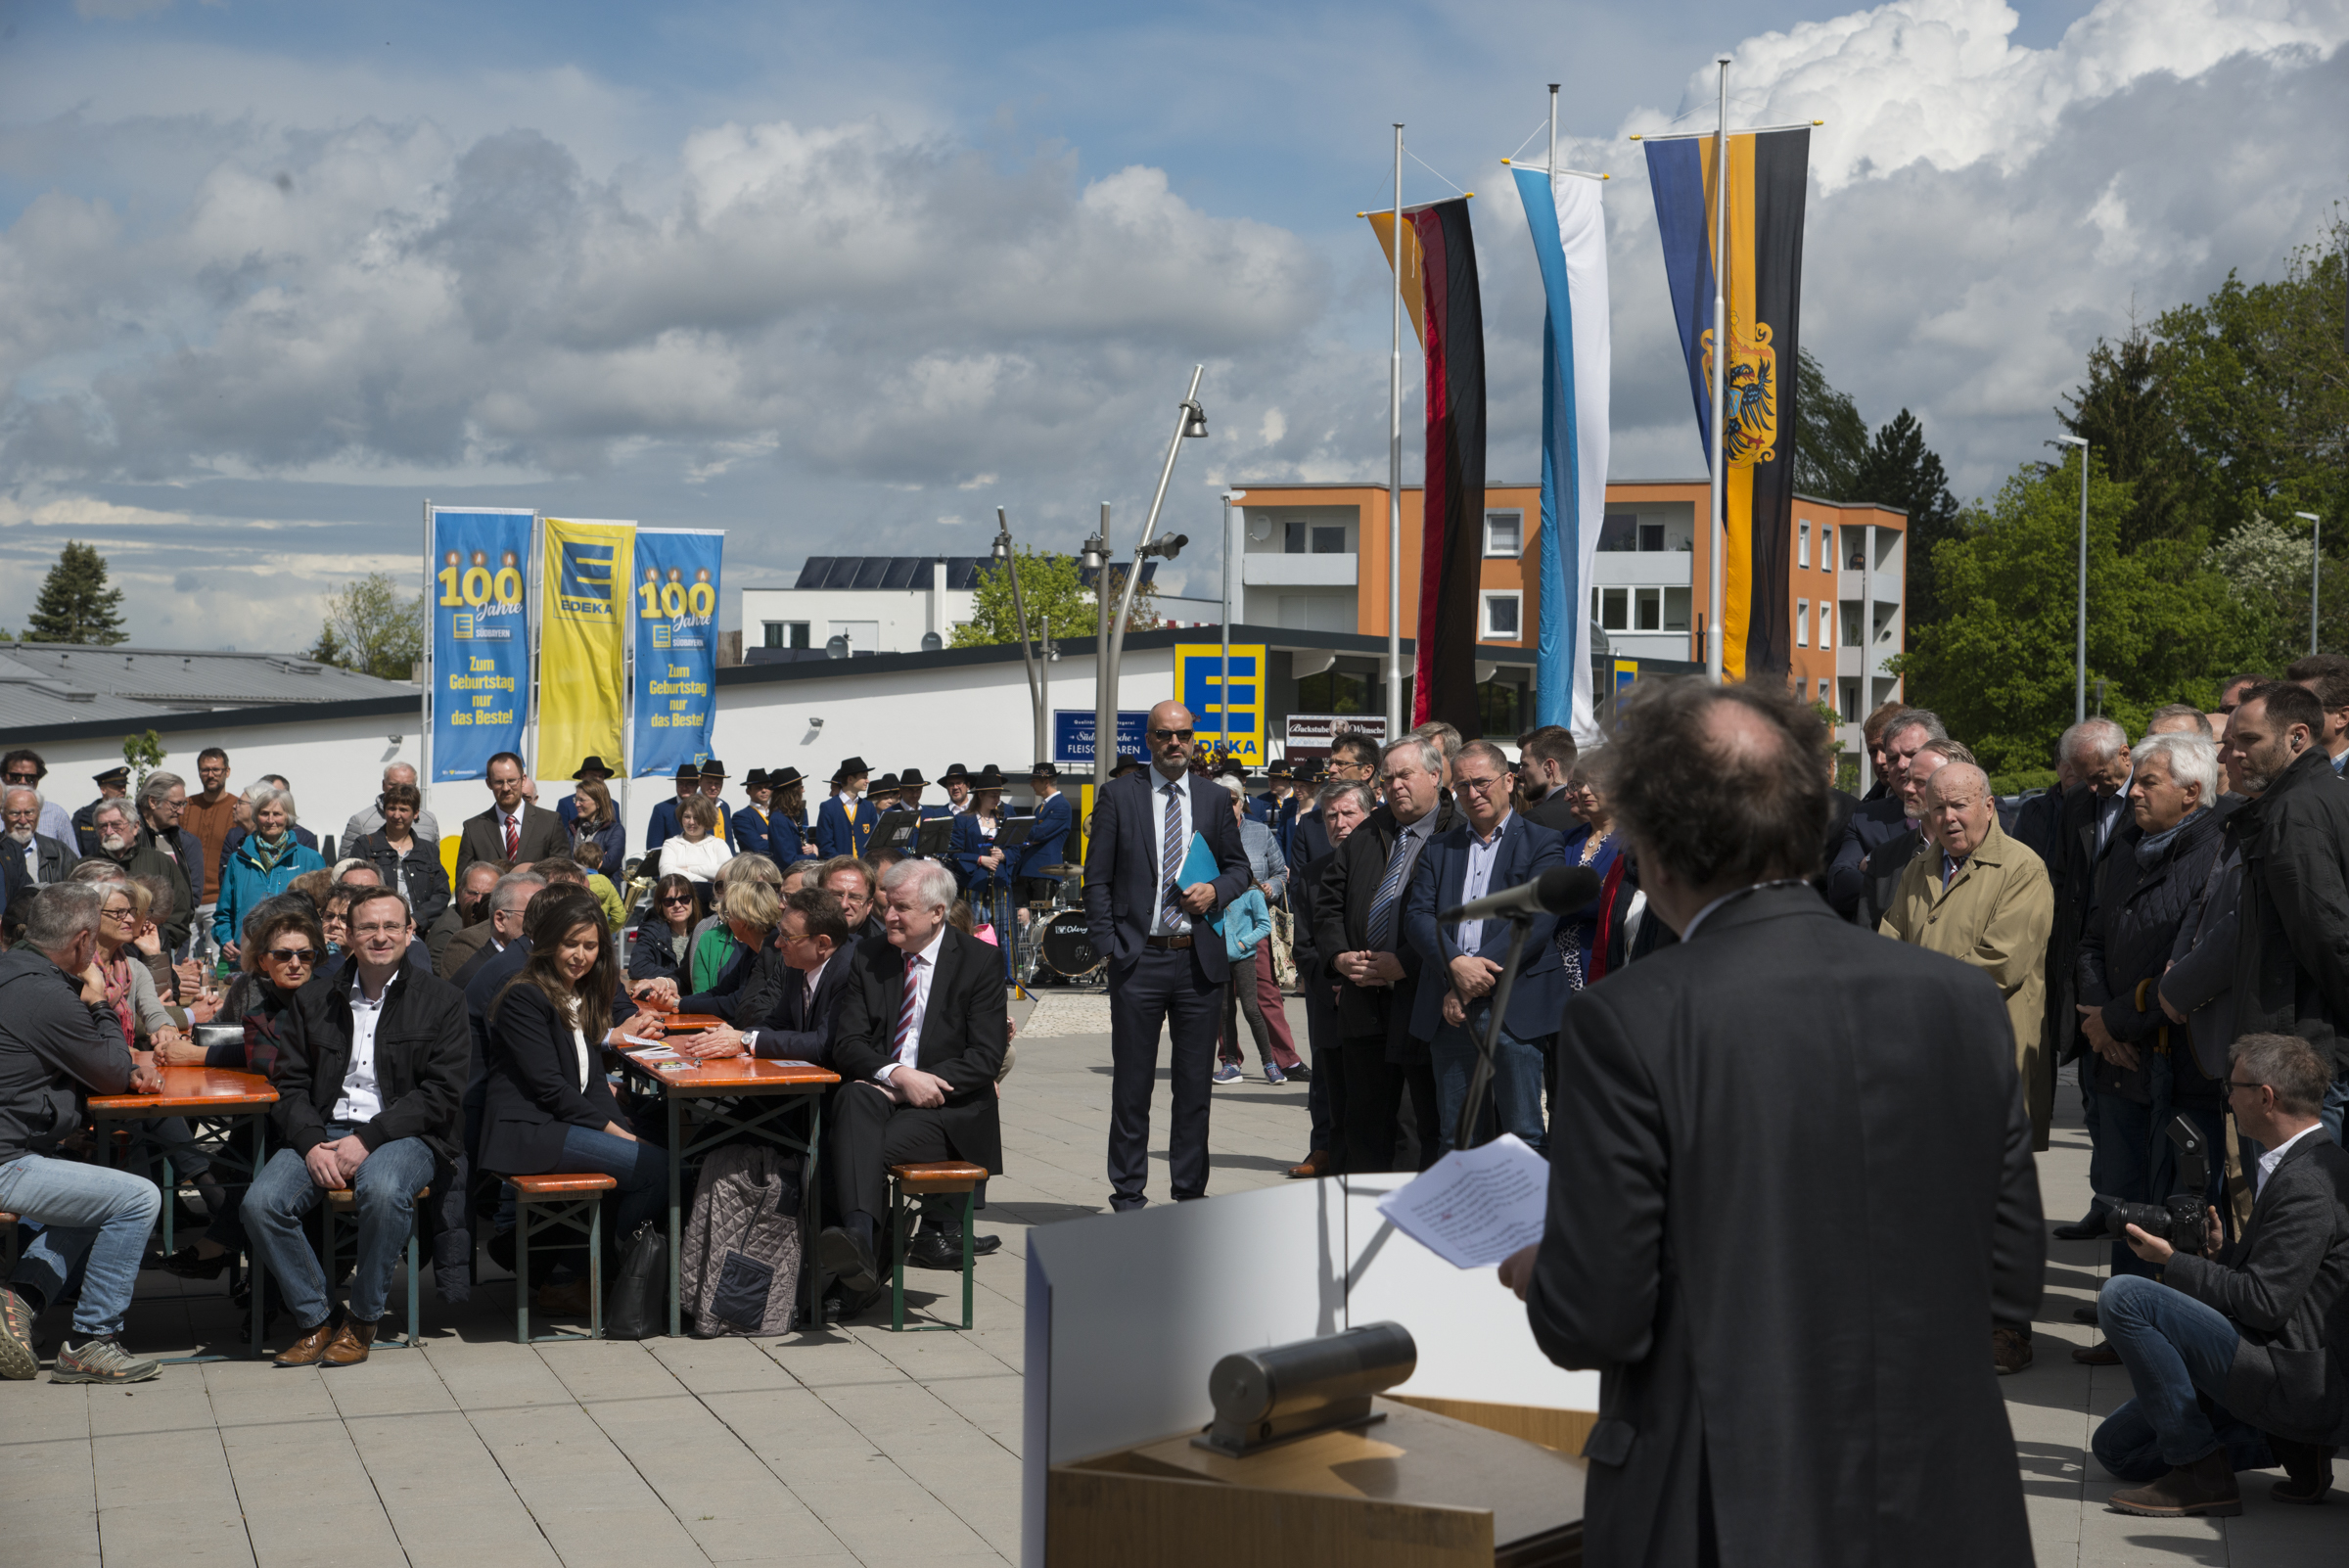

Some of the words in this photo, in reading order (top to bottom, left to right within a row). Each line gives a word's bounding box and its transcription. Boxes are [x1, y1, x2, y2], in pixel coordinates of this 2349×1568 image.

[438, 567, 523, 607] 100
[561, 599, 614, 615] EDEKA
[638, 581, 715, 619] 100
[476, 599, 523, 623] Jahre
[672, 612, 713, 633] Jahre
[476, 627, 511, 638] SÜDBAYERN
[470, 656, 494, 671] Zum
[668, 664, 690, 677] Zum
[449, 673, 515, 692] Geburtstag
[649, 680, 707, 697] Geburtstag
[472, 695, 493, 707] nur
[669, 700, 688, 711] nur
[451, 710, 473, 725] das
[476, 709, 514, 724] Beste!
[651, 713, 670, 727] das
[671, 713, 705, 727] Beste!
[1289, 723, 1330, 733] Backstube
[1349, 724, 1385, 734] Wünsche
